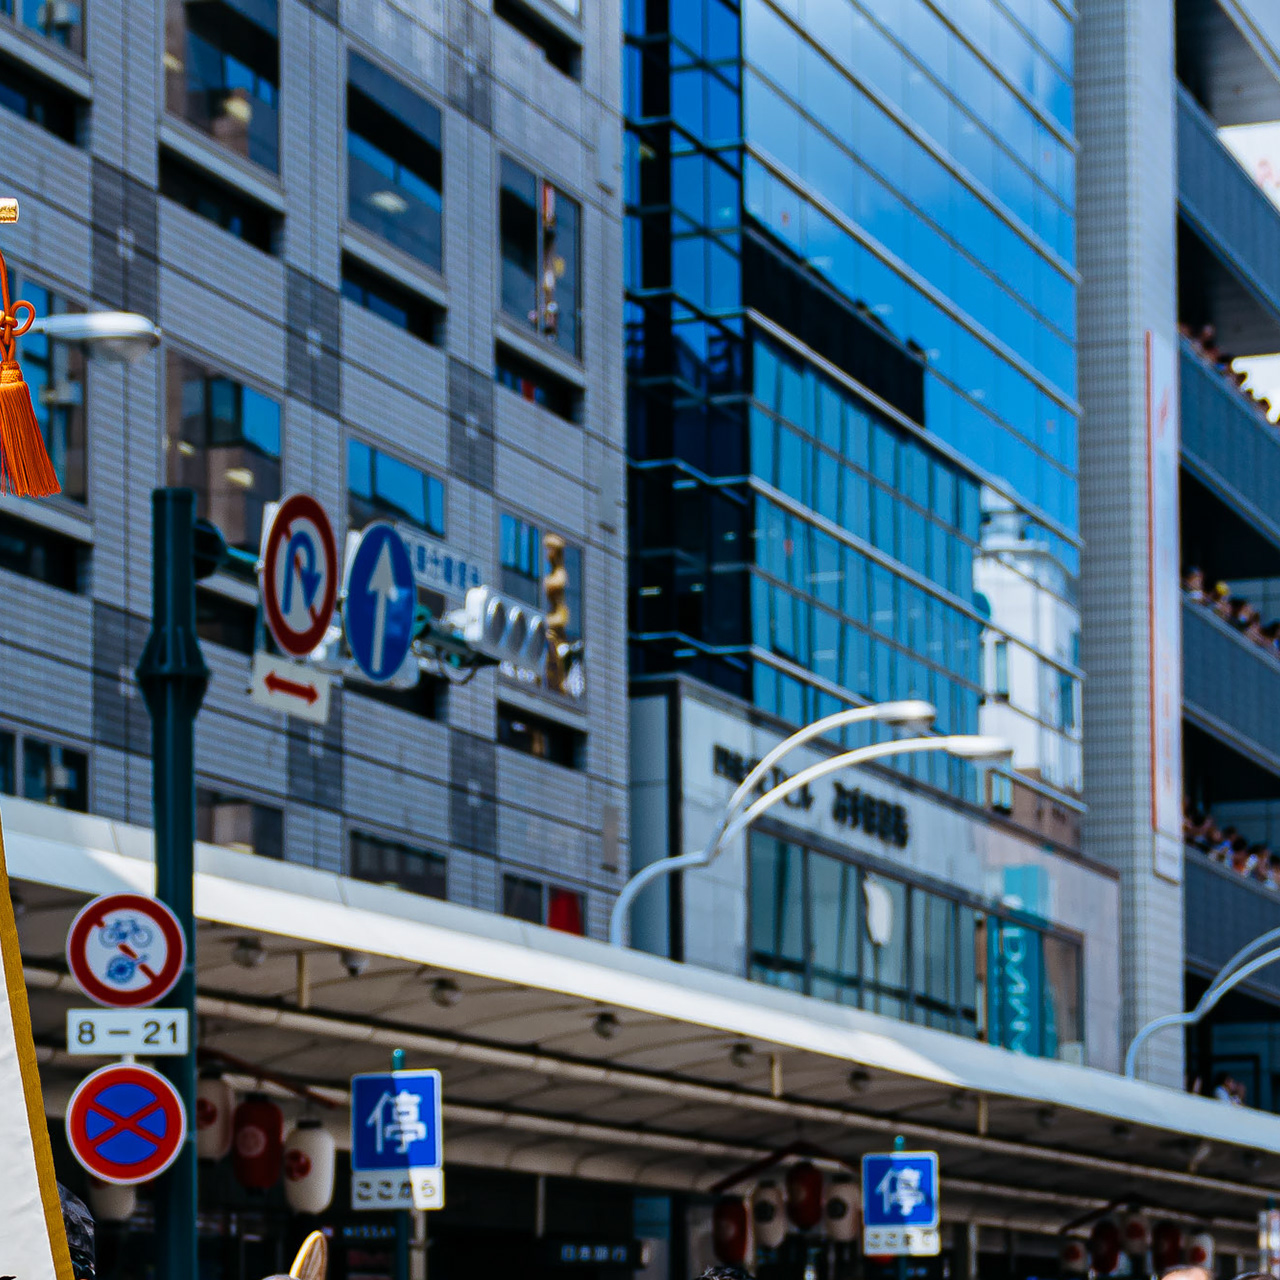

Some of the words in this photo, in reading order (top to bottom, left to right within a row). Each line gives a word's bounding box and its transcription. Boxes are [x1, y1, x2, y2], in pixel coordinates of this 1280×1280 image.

[365, 1088, 428, 1155] 停
[356, 1179, 437, 1201] ここから
[874, 1165, 927, 1216] 停
